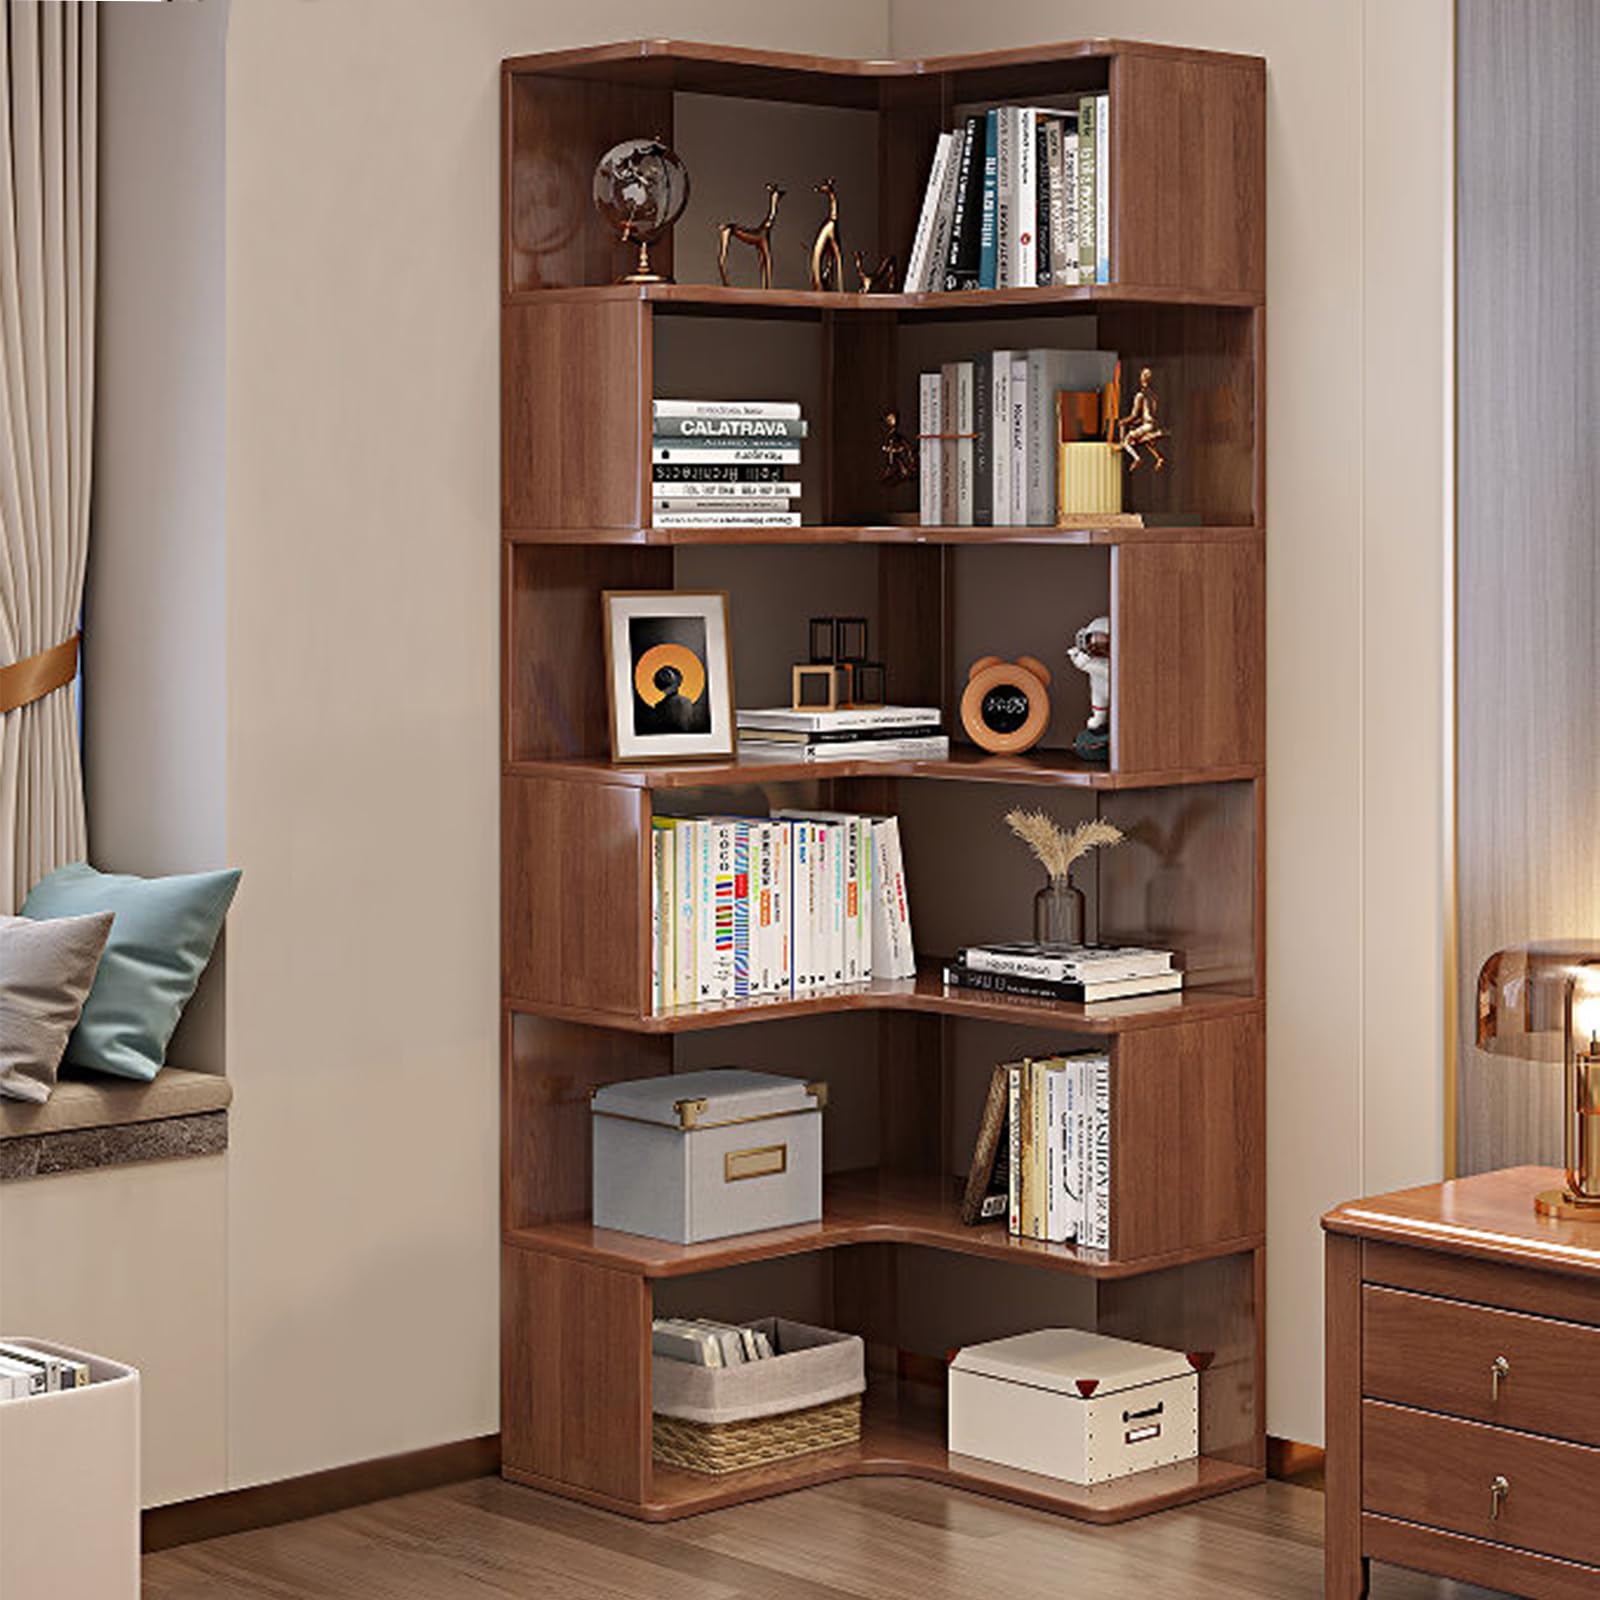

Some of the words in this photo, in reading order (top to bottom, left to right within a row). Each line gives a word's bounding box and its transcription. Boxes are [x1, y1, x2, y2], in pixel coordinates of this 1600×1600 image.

[680, 420, 787, 436] CALATRAVA
[1095, 1069, 1108, 1102] THE
[1095, 1105, 1108, 1187] FASHION
